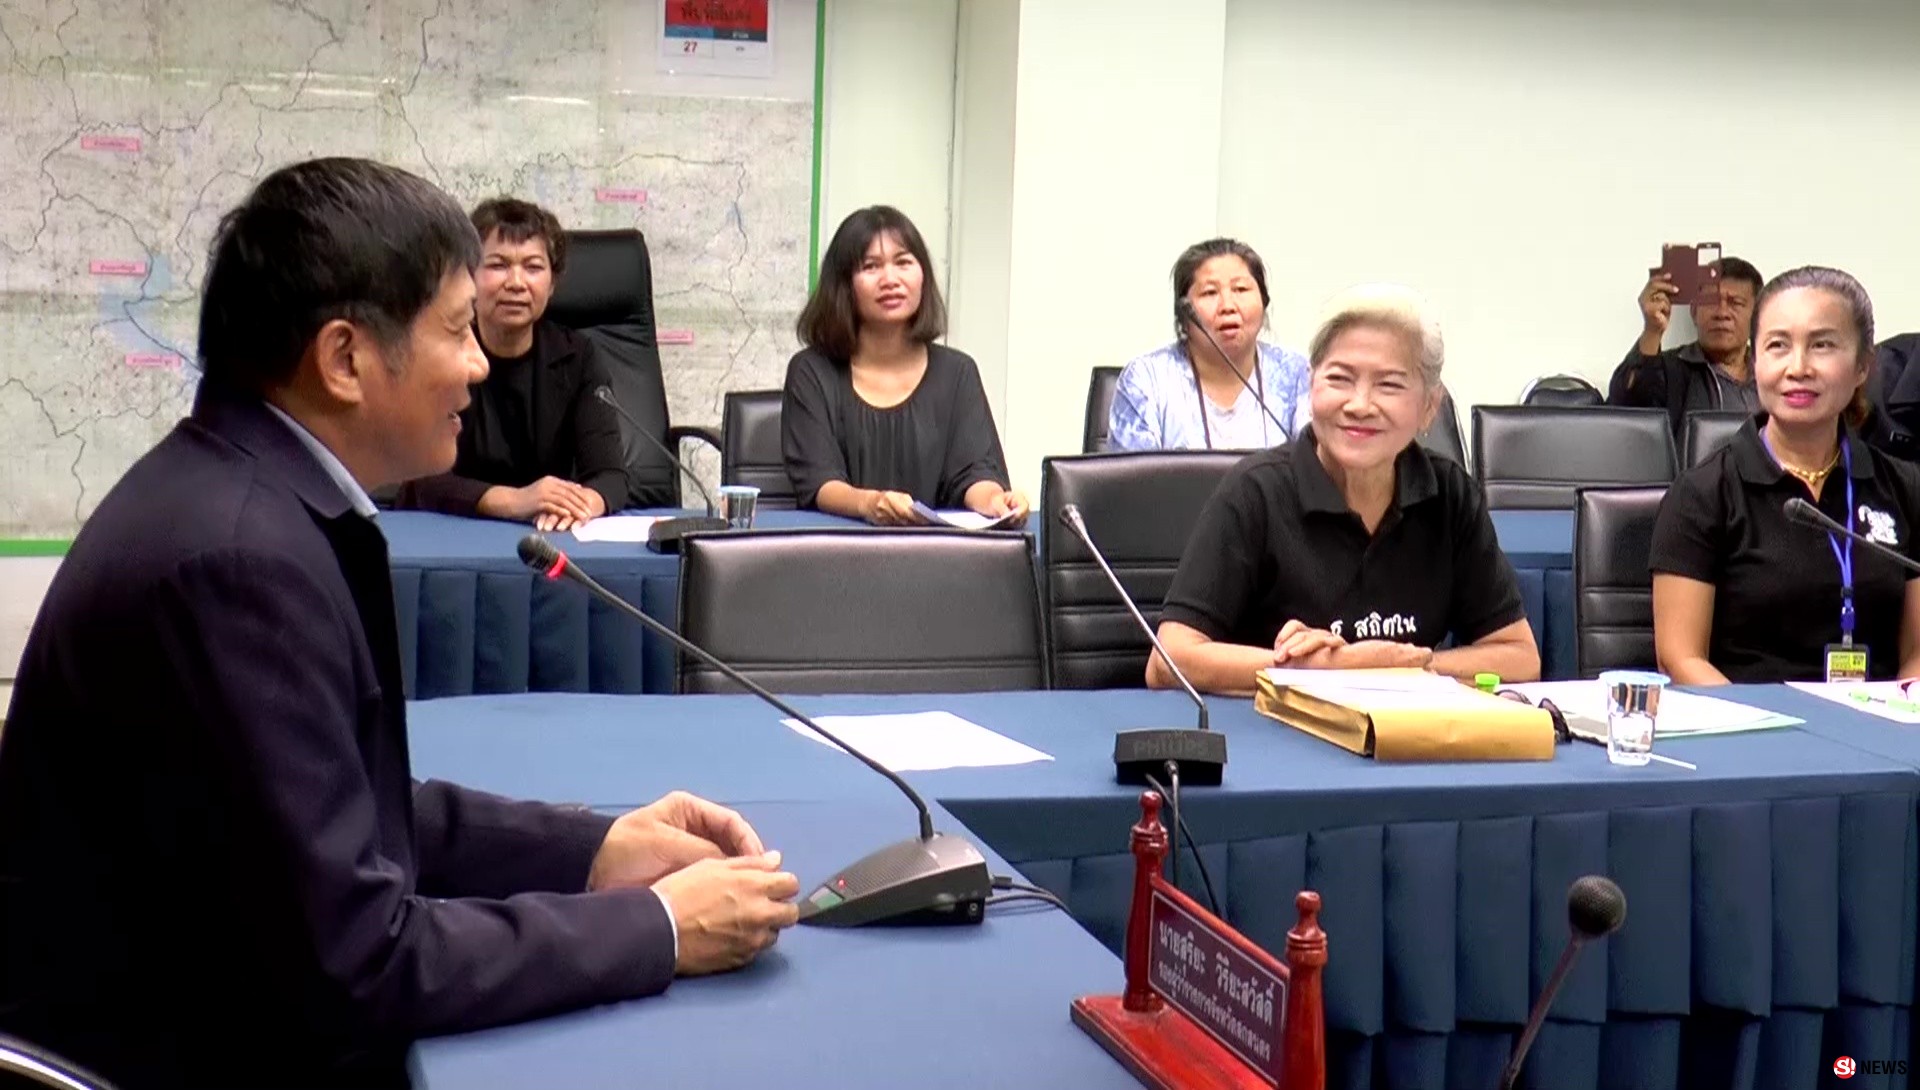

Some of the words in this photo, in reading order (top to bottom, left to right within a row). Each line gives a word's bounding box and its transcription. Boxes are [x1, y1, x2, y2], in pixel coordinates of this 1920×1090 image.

[683, 41, 698, 53] 27
[1354, 611, 1417, 638] สถิตใน
